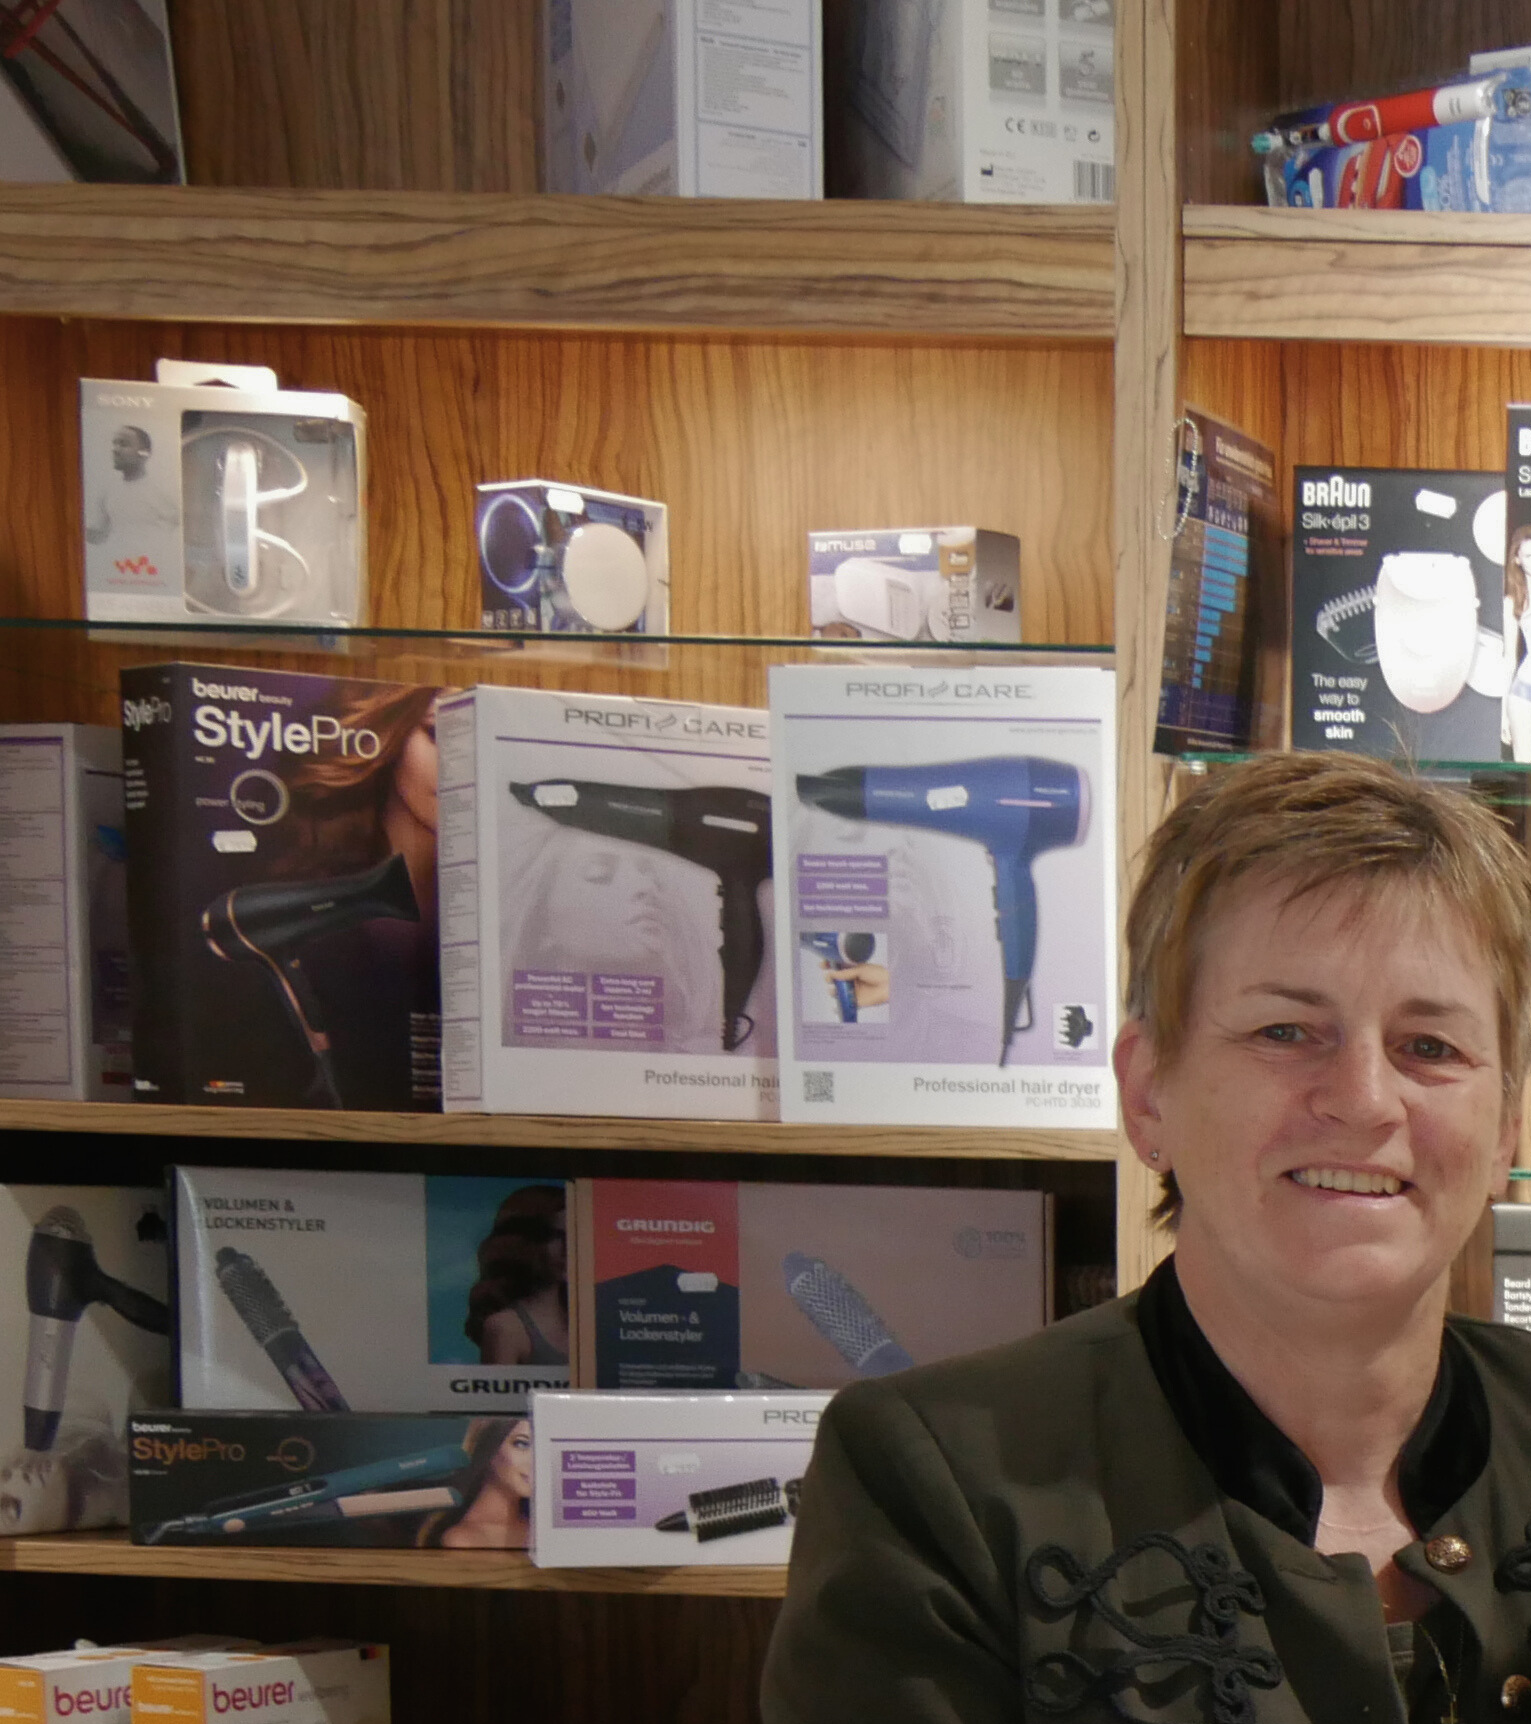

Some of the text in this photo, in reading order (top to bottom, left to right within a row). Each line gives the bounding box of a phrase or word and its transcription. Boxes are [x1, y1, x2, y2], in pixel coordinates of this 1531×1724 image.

[97, 394, 154, 408] SONY
[1303, 475, 1371, 508] BRAUN
[1358, 514, 1370, 530] 3
[192, 678, 259, 702] beurer
[846, 682, 1032, 699] PROFI CARE
[1312, 673, 1367, 691] The easy
[1320, 692, 1360, 707] way to
[124, 696, 172, 731] StylePro
[1314, 709, 1365, 722] smooth
[194, 705, 382, 760] StylePro
[564, 708, 767, 740] PROFI CARE
[1325, 726, 1354, 739] skin
[645, 1071, 746, 1088] Professional
[914, 1078, 1101, 1099] Professional hair dryer
[204, 1197, 295, 1213] VOLUMEN &
[205, 1216, 326, 1233] LOCKENSTYLER
[617, 1219, 715, 1234] GRUNDIG
[1504, 1278, 1531, 1289] Beard
[619, 1310, 699, 1324] Volumen &
[619, 1328, 702, 1343] Lockenstyler
[132, 1421, 171, 1434] beurer
[133, 1437, 245, 1462] StylePro
[53, 1685, 133, 1716] beure
[212, 1680, 295, 1714] beurer
